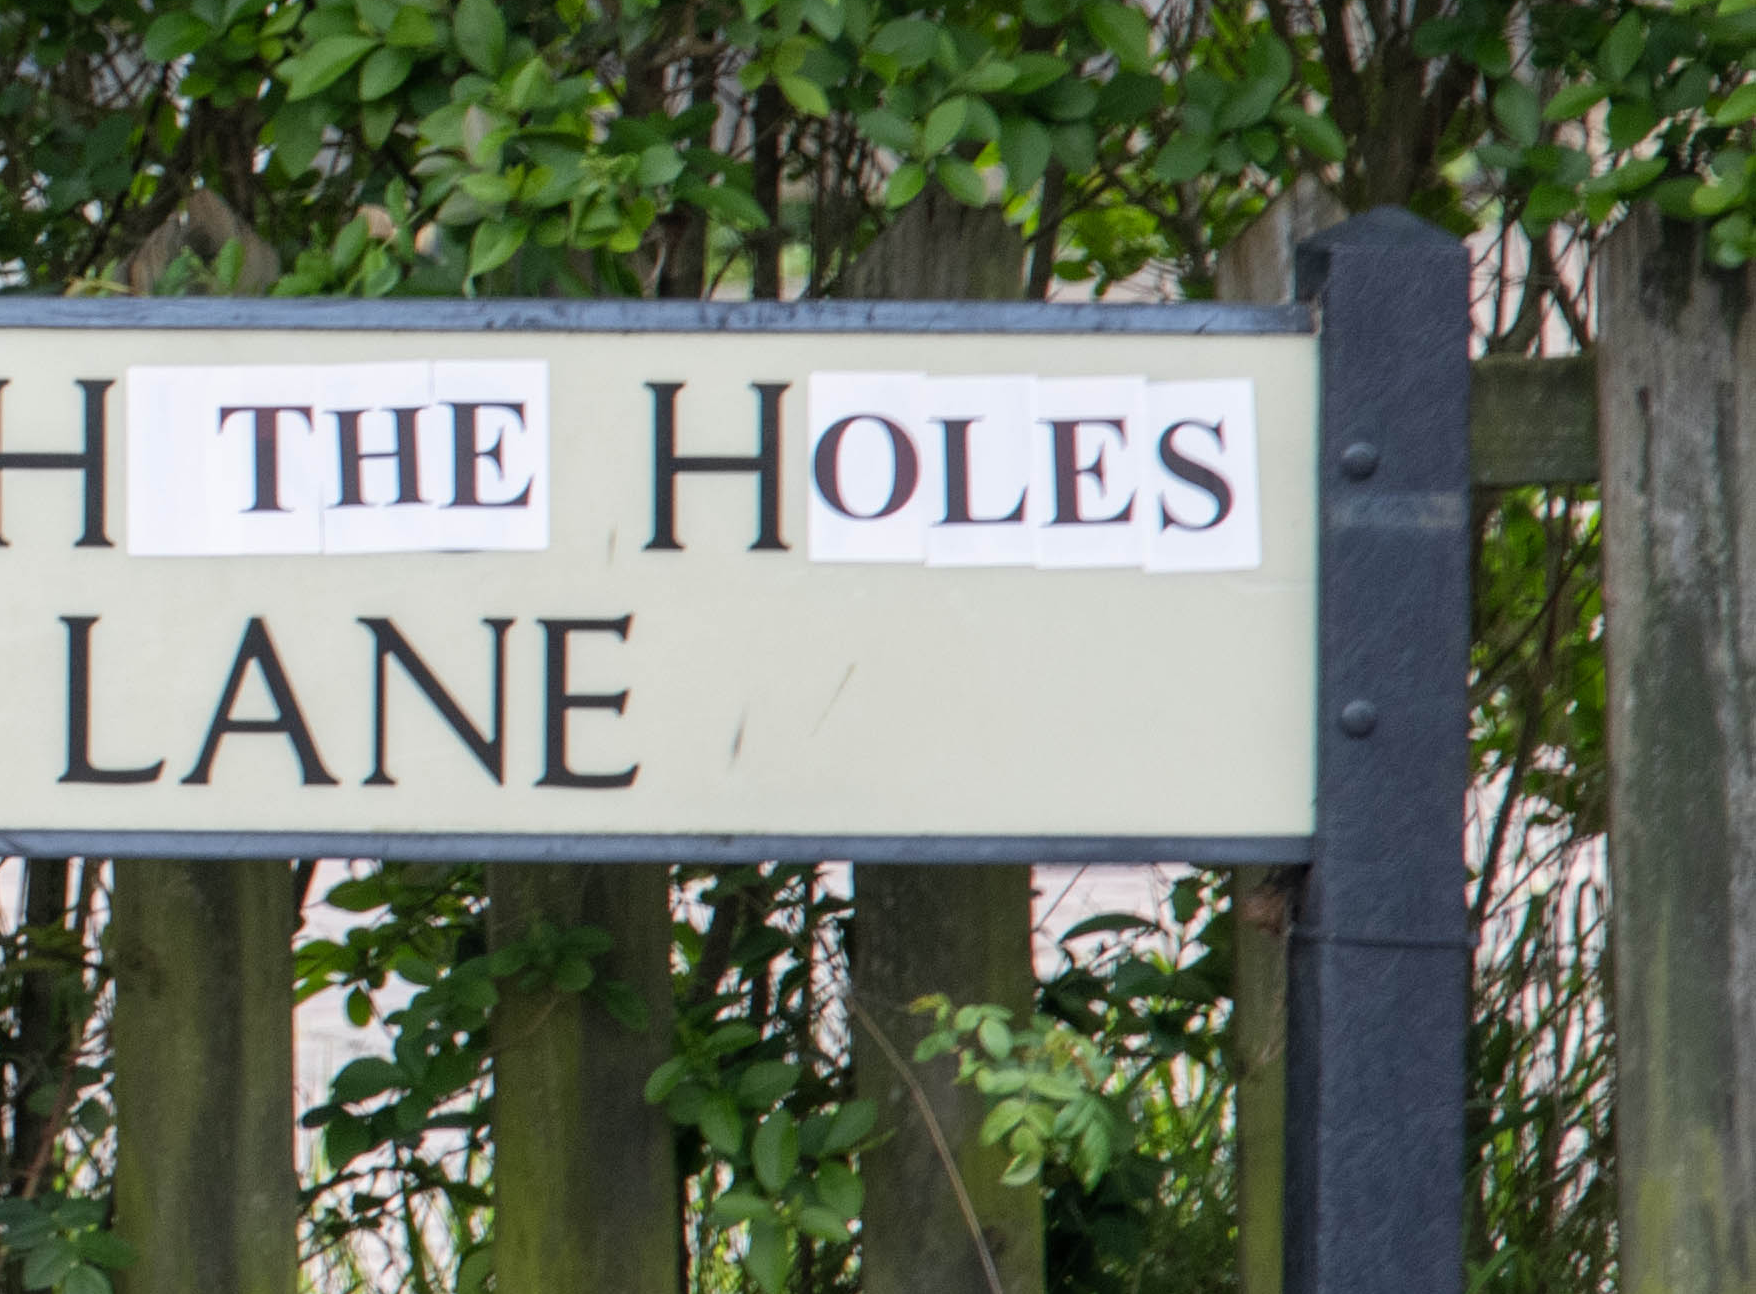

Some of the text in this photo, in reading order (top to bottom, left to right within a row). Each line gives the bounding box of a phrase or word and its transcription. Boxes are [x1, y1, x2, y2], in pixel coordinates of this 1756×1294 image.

[217, 400, 534, 513] THE
[642, 379, 1235, 553] HOLES
[56, 613, 641, 789] LANE
